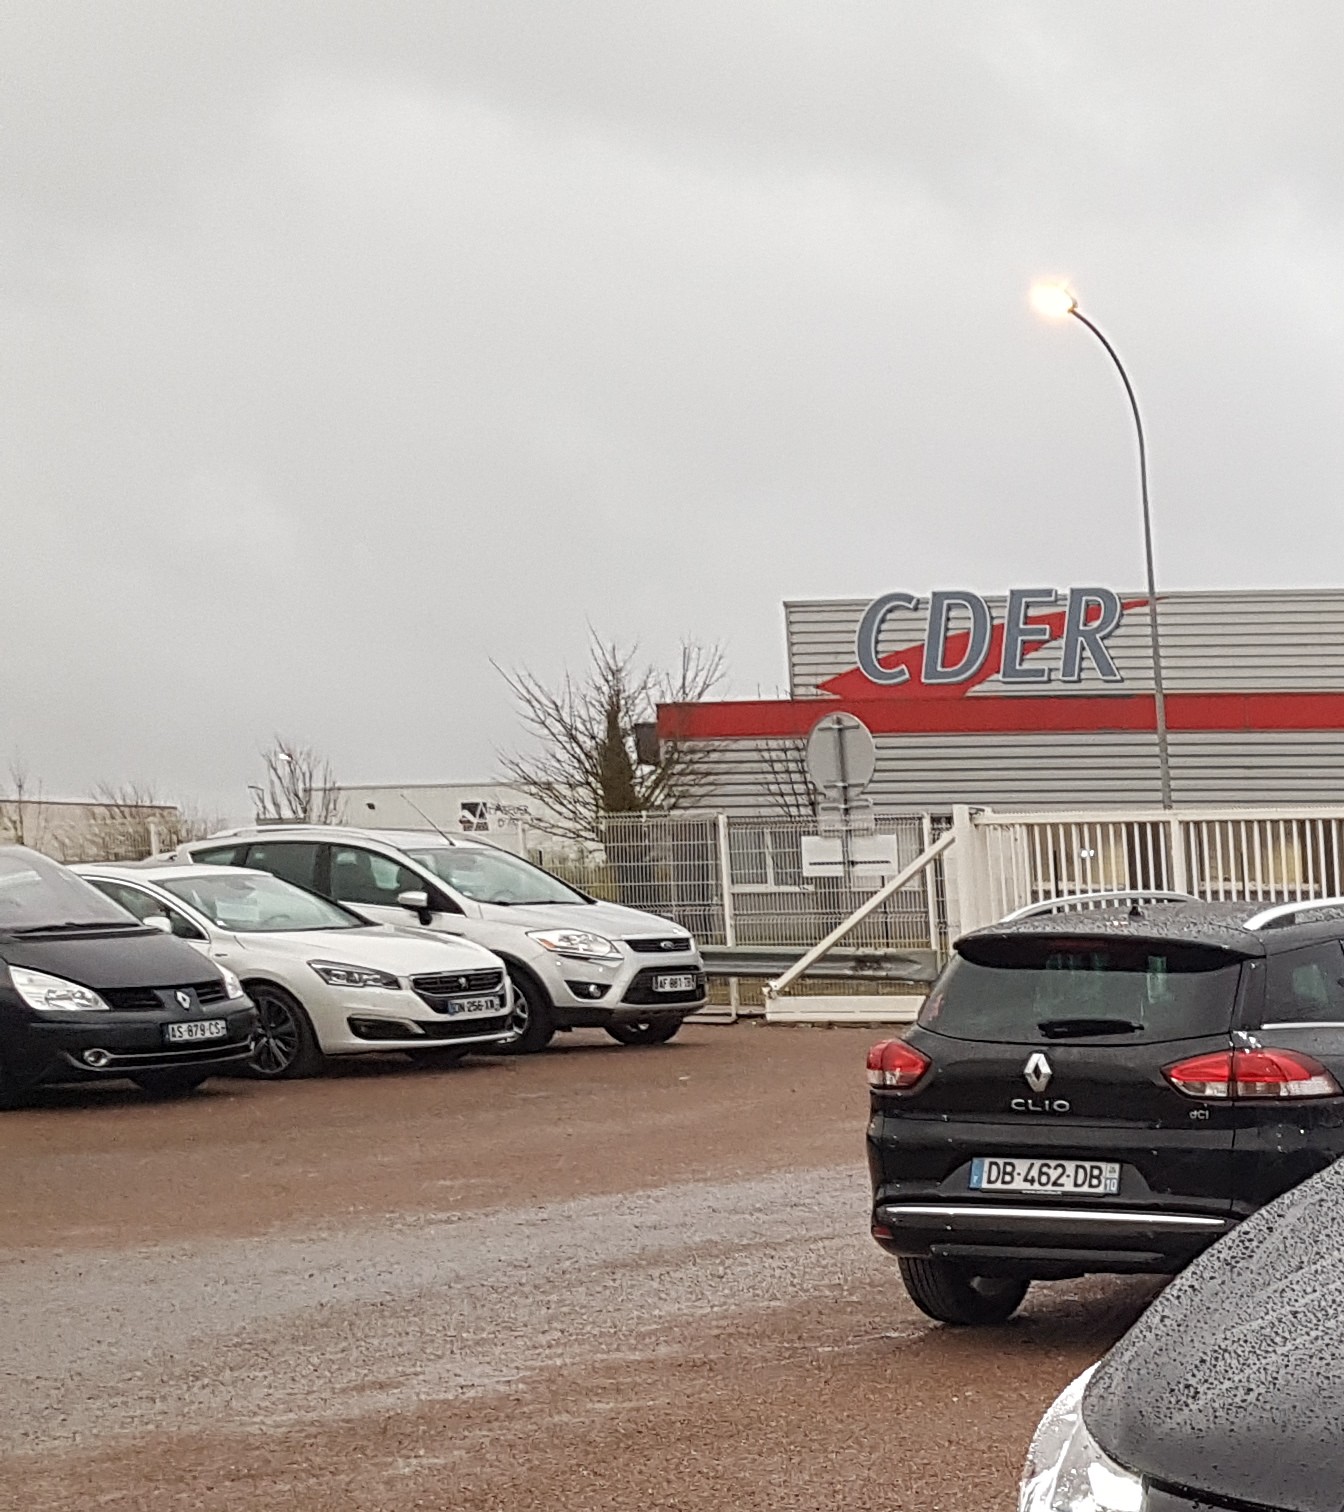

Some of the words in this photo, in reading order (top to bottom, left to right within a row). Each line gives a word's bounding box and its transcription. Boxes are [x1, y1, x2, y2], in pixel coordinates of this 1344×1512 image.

[856, 587, 1124, 684] CDER
[1010, 1098, 1071, 1112] CLIO
[986, 1160, 1104, 1189] DB-462-DB
